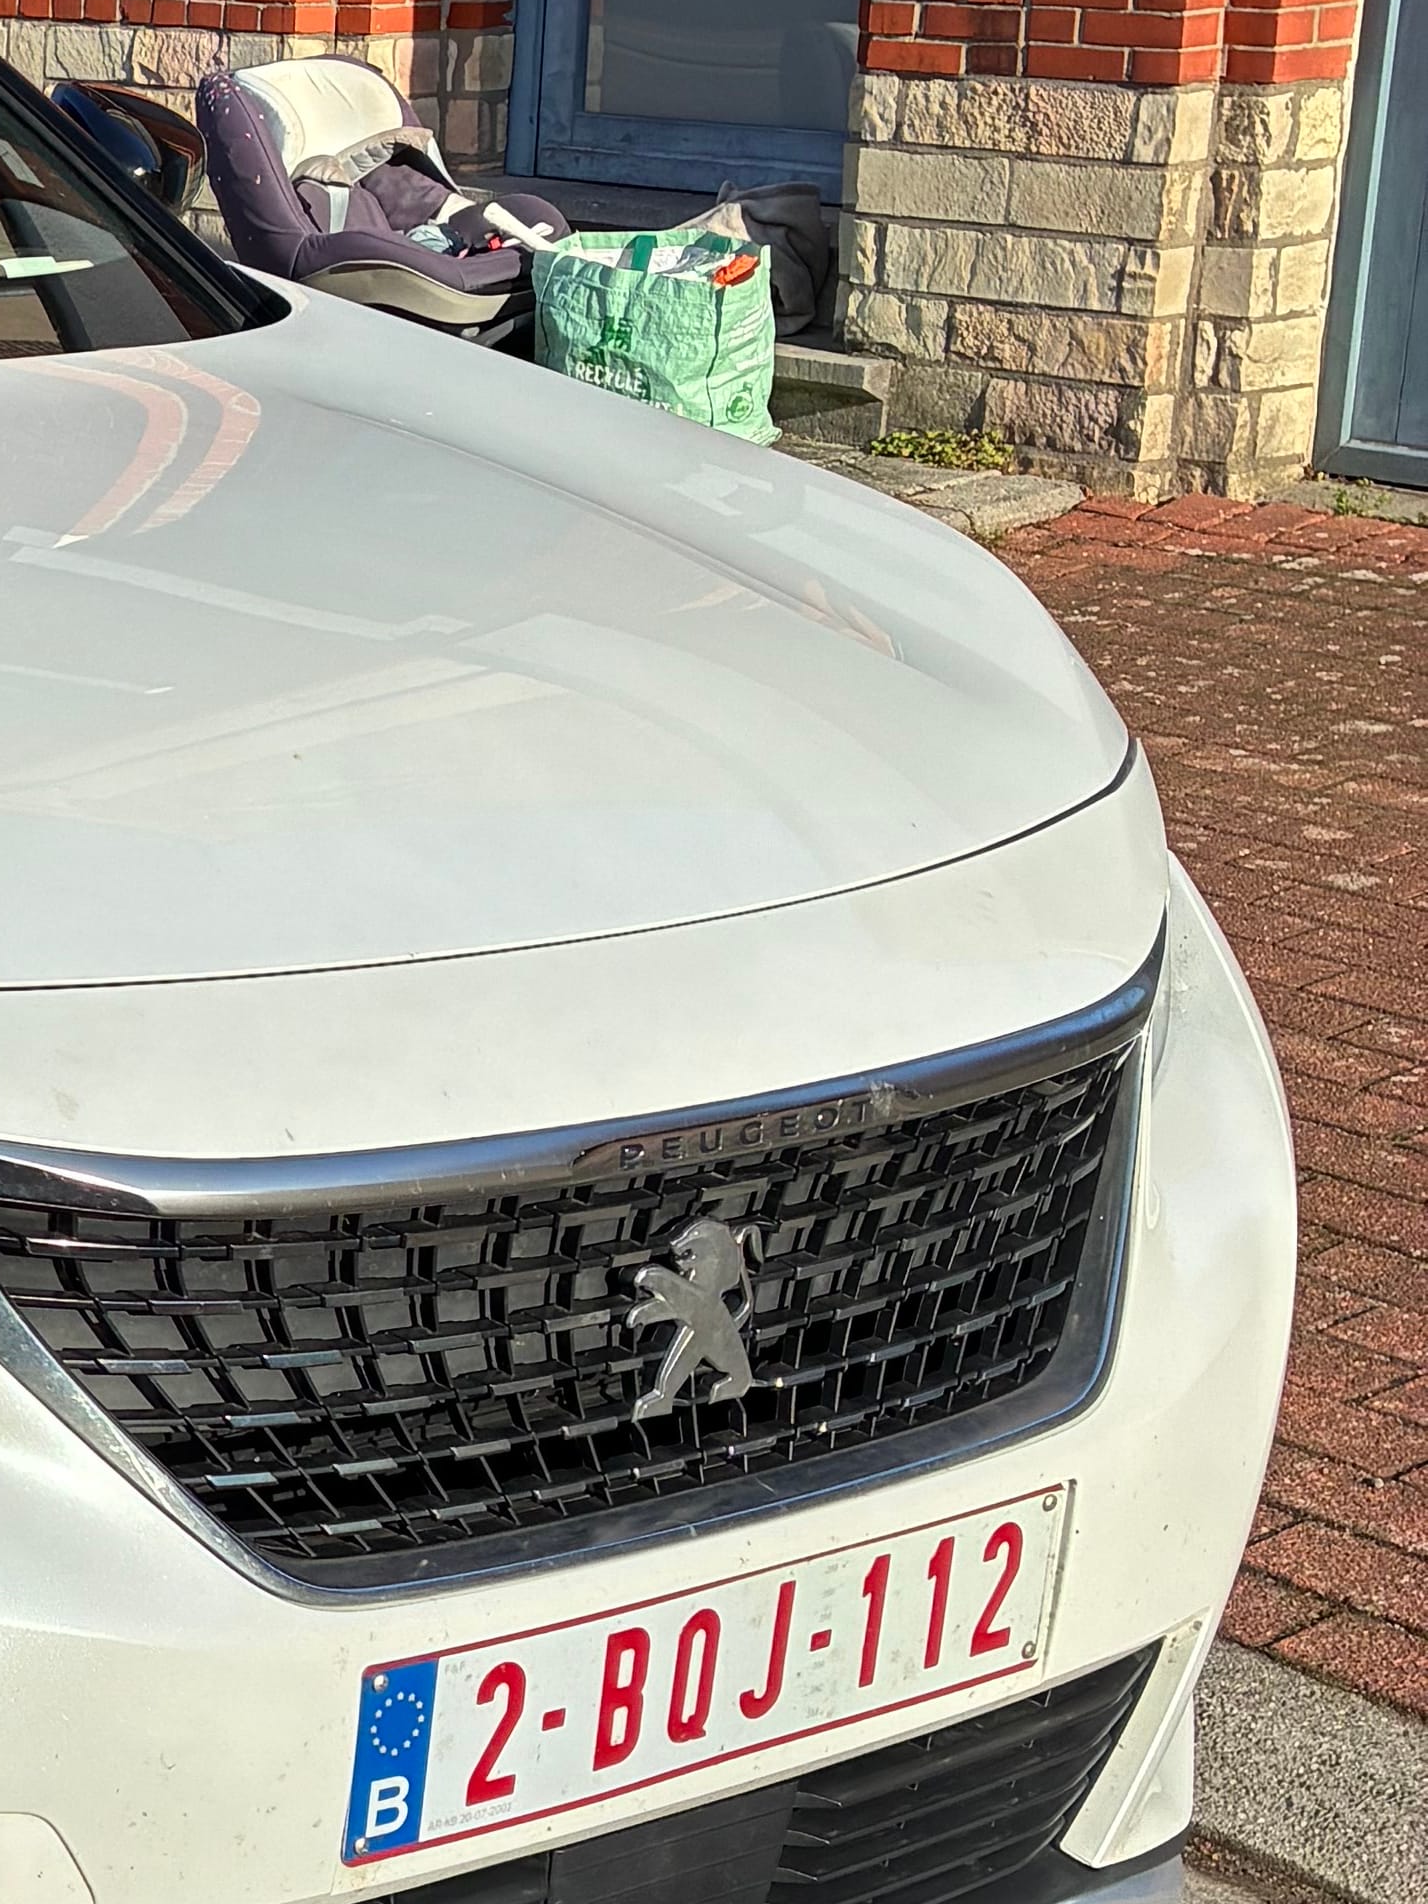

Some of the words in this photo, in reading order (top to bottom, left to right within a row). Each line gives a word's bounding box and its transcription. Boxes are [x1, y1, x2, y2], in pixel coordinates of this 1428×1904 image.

[618, 1099, 874, 1171] PEUGEOT
[464, 1520, 1025, 1808] 2-BQJ-112
[365, 1775, 410, 1839] B
